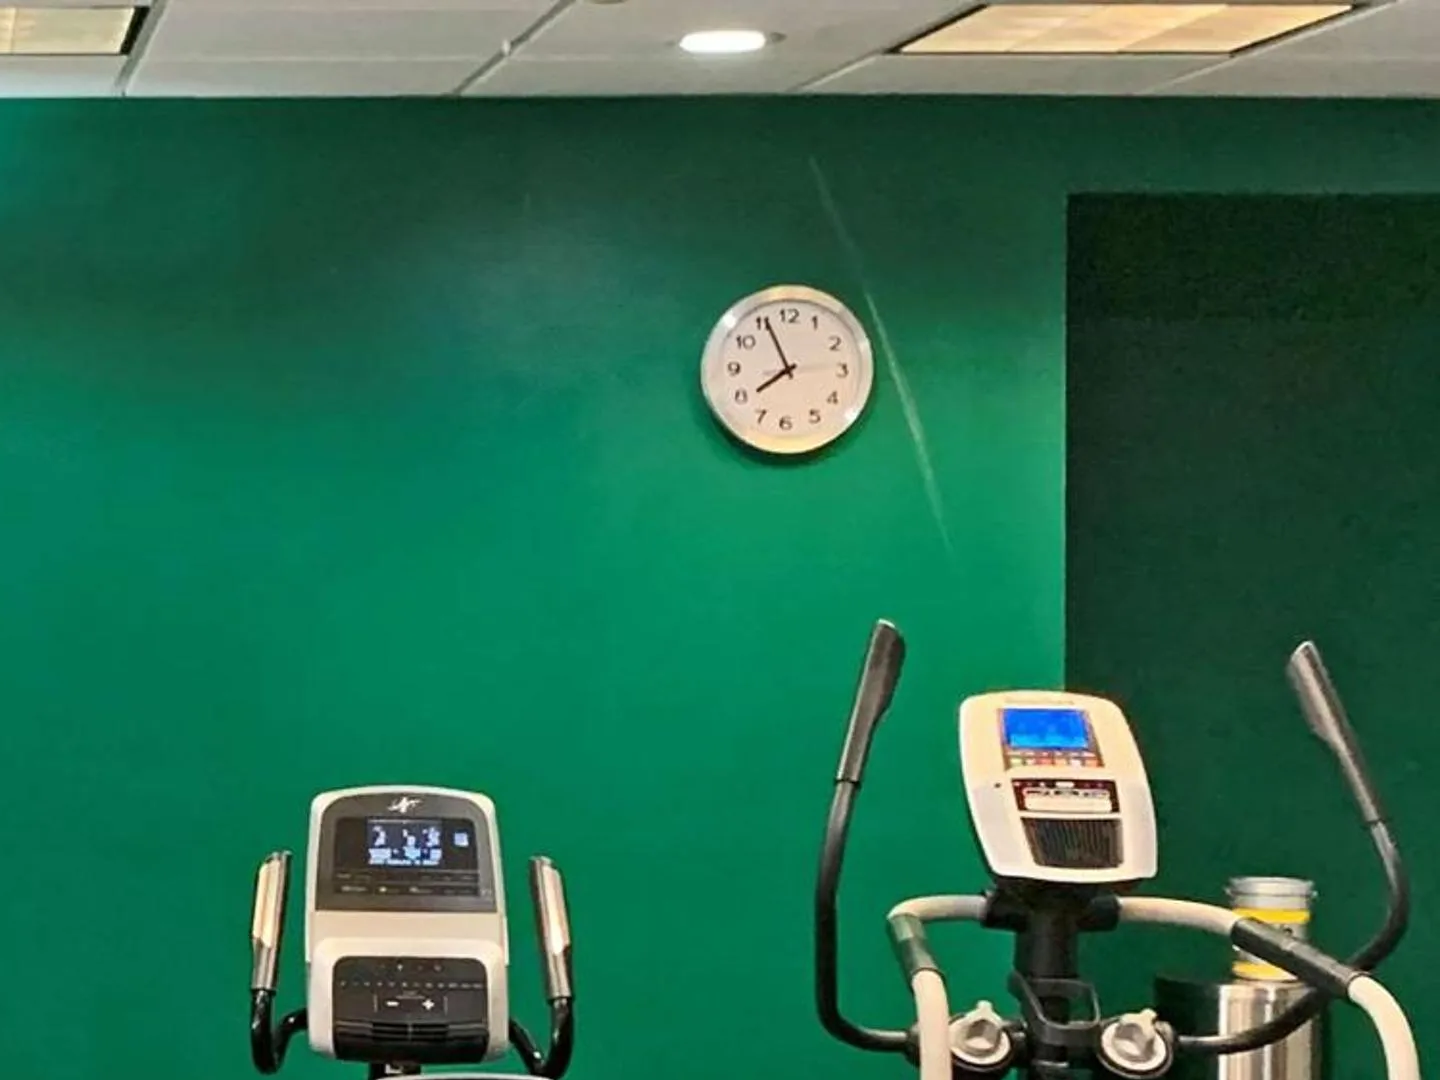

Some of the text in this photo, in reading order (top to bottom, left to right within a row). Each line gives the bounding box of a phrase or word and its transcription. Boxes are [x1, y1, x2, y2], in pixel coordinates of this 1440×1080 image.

[780, 309, 800, 324] 12
[811, 315, 819, 330] 1
[736, 335, 756, 350] 10
[829, 336, 841, 351] 2
[727, 361, 741, 376] 9
[836, 363, 849, 378] 3
[734, 389, 748, 404] 8
[827, 390, 839, 405] 4
[755, 409, 768, 424] 7
[779, 415, 793, 431] 6
[809, 409, 821, 424] 5
